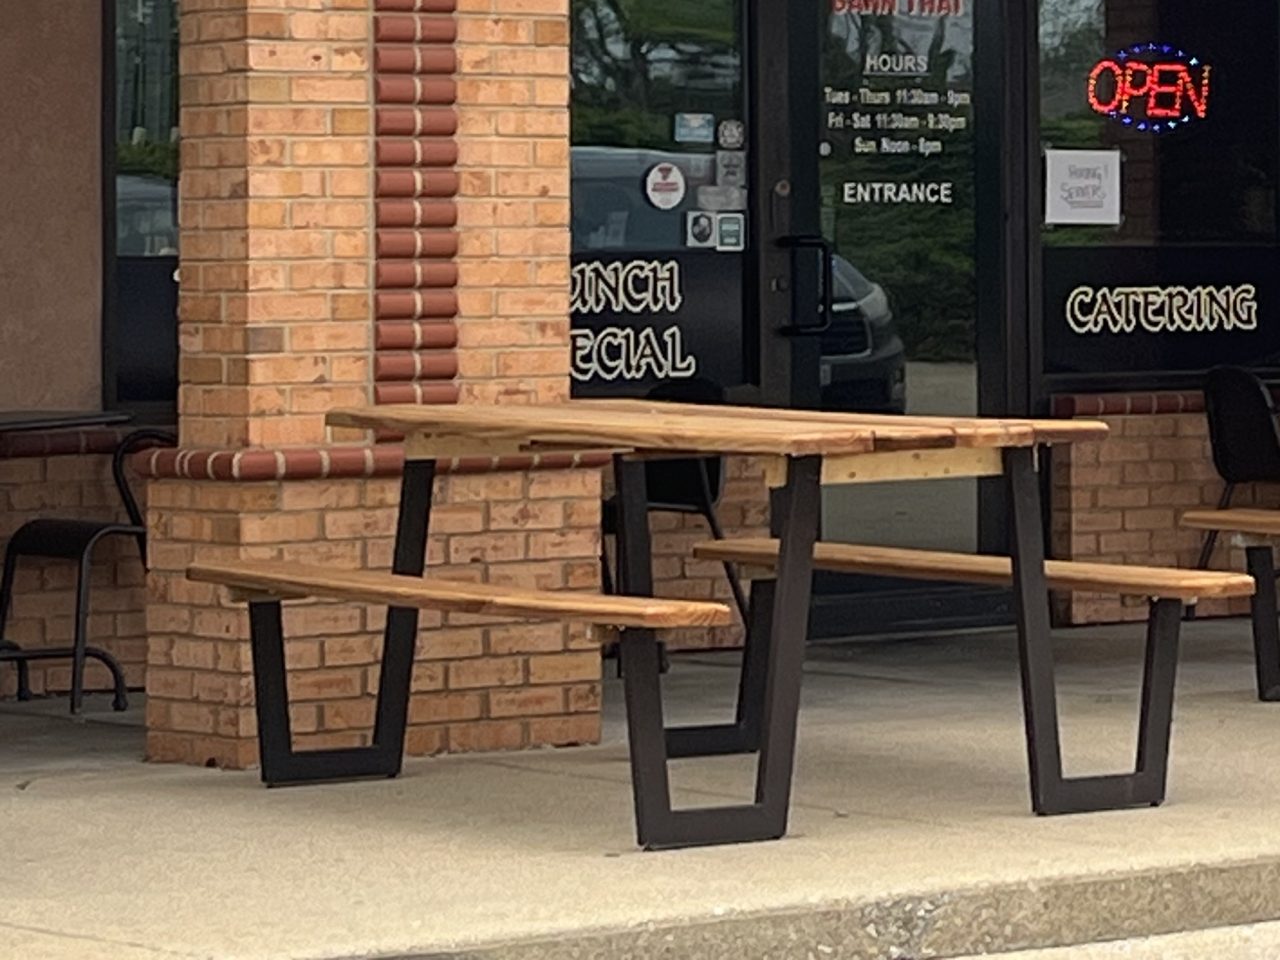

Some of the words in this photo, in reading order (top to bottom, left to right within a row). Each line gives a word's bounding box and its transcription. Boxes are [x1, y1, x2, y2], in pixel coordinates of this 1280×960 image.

[866, 54, 928, 72] HOURS
[1087, 59, 1212, 118] OPEN
[828, 112, 844, 128] Fri
[852, 112, 871, 128] Sat
[875, 113, 919, 128] 11:30am
[843, 182, 952, 203] ENTRANCE
[571, 260, 682, 313] UNCH
[1066, 284, 1257, 333] CATERING
[571, 325, 696, 380] ECIAL
